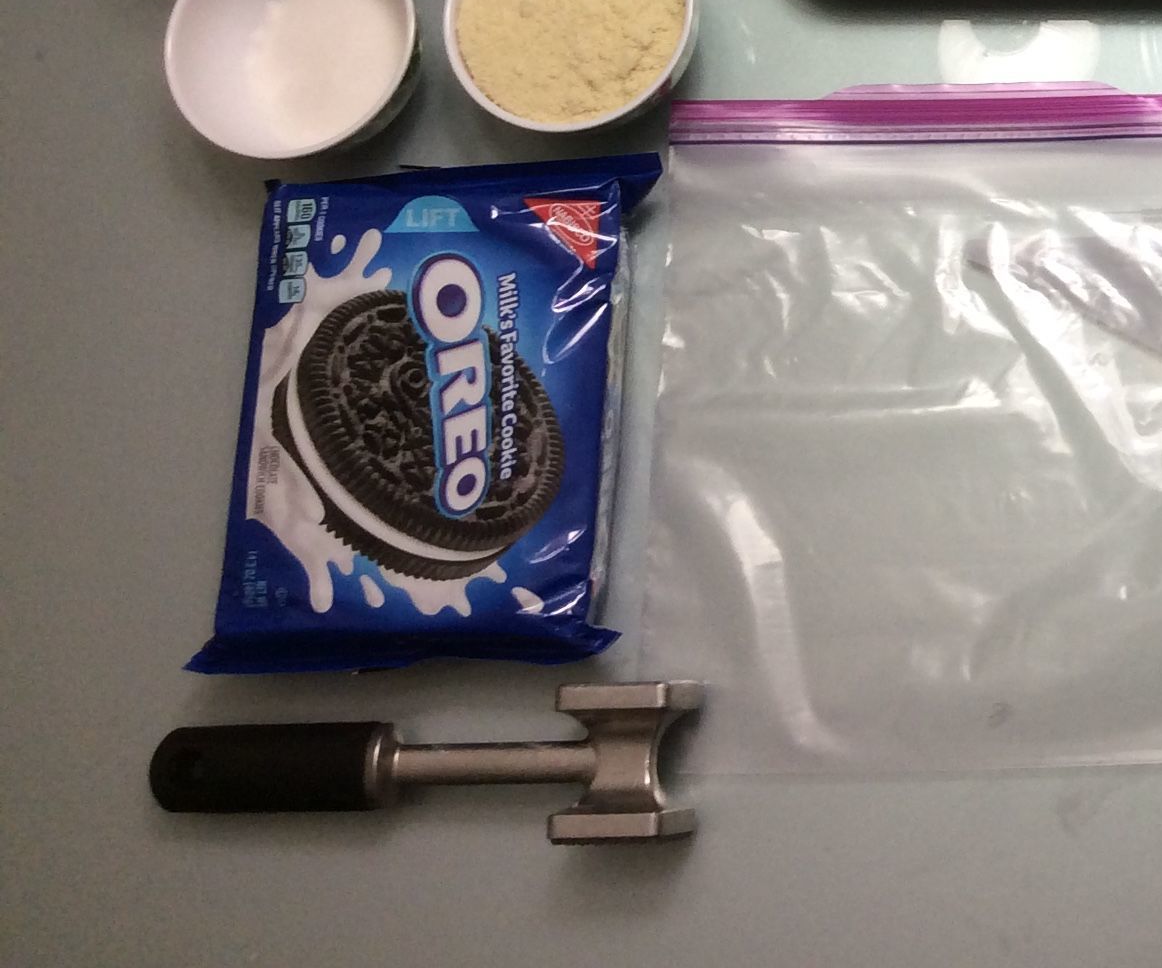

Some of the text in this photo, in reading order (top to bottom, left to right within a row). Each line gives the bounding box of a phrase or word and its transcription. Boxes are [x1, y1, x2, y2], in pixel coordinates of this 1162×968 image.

[301, 202, 313, 219] 160
[406, 208, 462, 228] LIFT
[415, 255, 488, 514] OREO
[497, 271, 519, 480] Milk's Favorite Cookie
